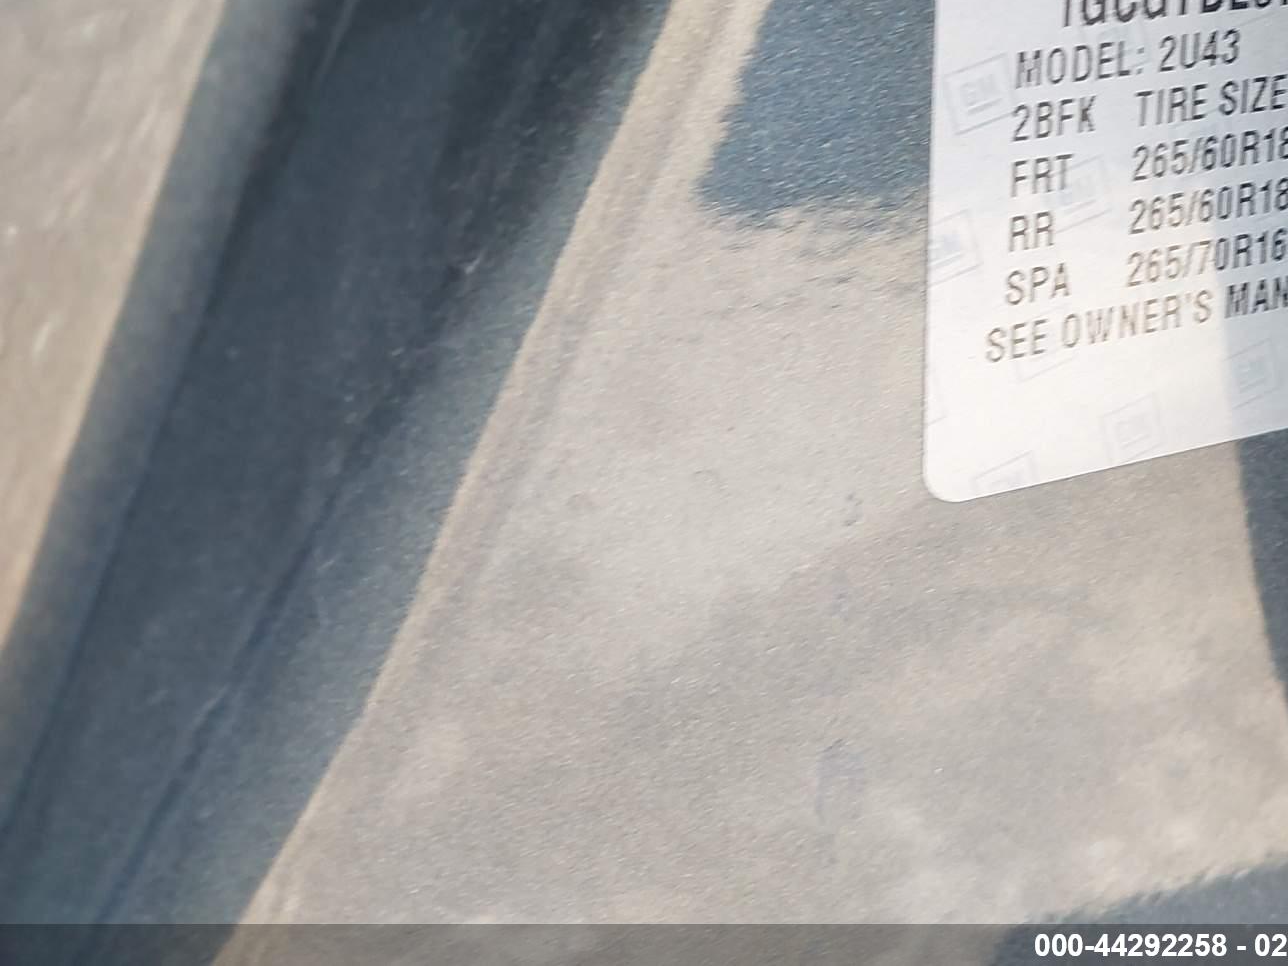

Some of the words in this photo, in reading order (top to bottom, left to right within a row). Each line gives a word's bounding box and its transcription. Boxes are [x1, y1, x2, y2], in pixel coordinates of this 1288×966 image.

[1015, 45, 1146, 90] MODEL:
[1159, 29, 1241, 73] 2U43
[1013, 95, 1096, 142] 2BFK
[1137, 84, 1205, 127] TIRE
[1219, 74, 1288, 116] SIZE
[1010, 155, 1074, 198] FRT
[1009, 211, 1055, 252] RR
[1126, 228, 1288, 287] 265/70R16
[1004, 263, 1071, 307] SPA
[986, 321, 1048, 364] SEE
[1061, 289, 1213, 348] OWNER'S
